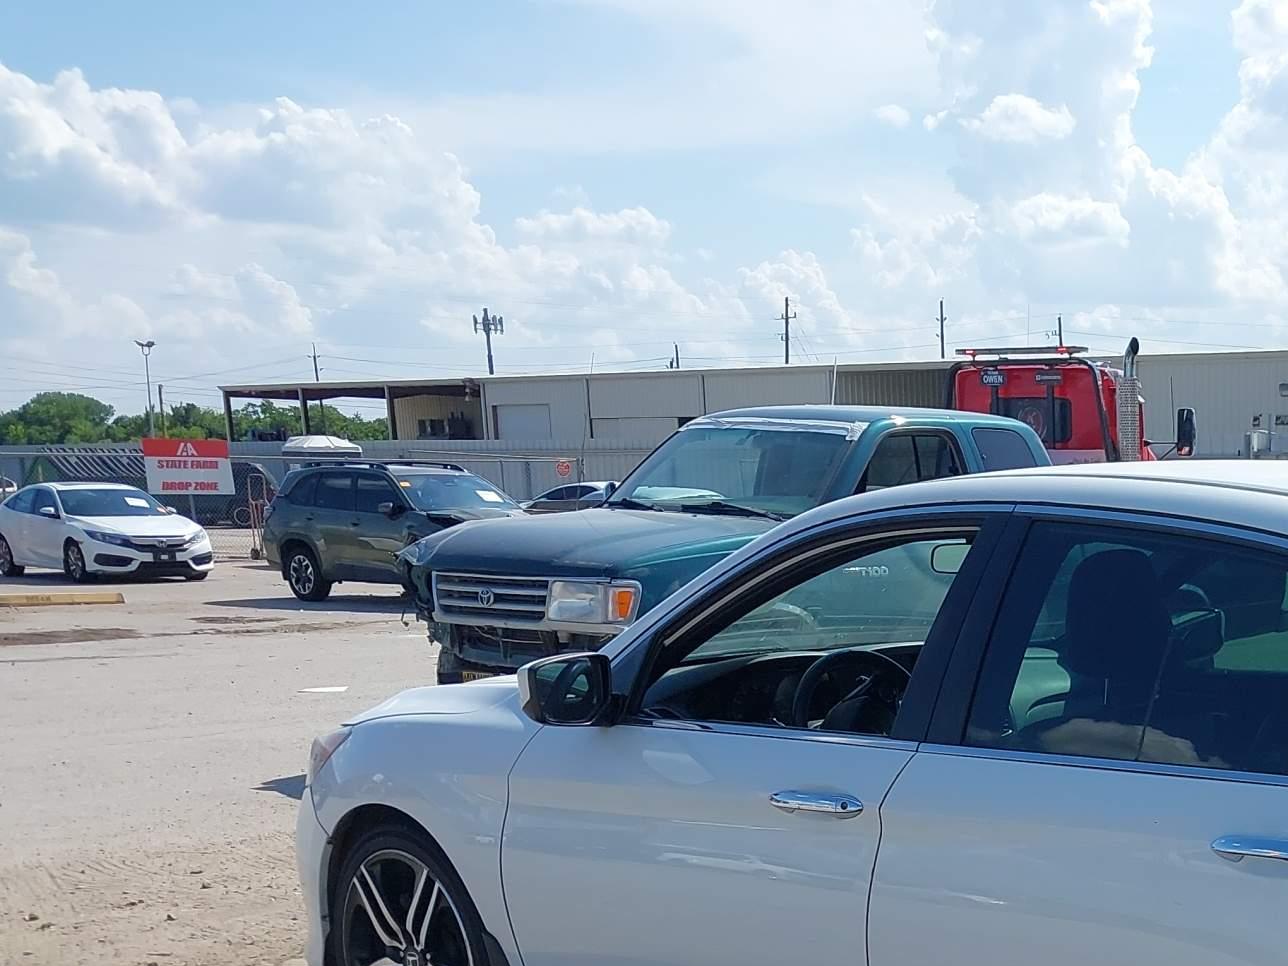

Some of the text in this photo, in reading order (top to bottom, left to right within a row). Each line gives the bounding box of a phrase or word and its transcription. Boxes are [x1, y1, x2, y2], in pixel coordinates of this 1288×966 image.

[157, 460, 218, 469] STATE FARM
[162, 481, 219, 490] DROP ZONE
